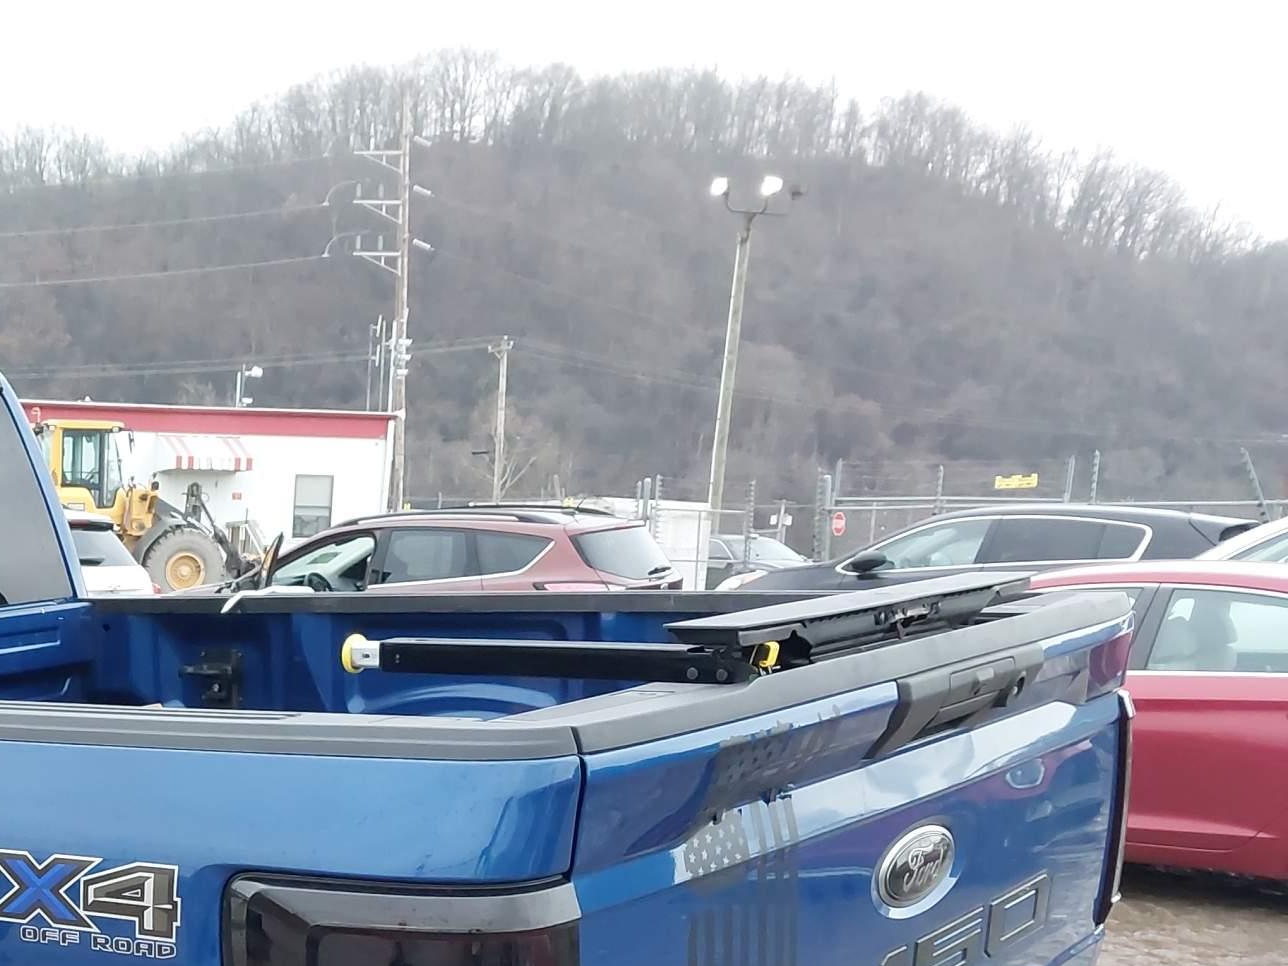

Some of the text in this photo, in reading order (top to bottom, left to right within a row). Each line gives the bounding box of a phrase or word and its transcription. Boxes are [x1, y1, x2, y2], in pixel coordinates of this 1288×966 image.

[902, 843, 945, 893] Ford
[20, 925, 177, 960] OFF ROAD
